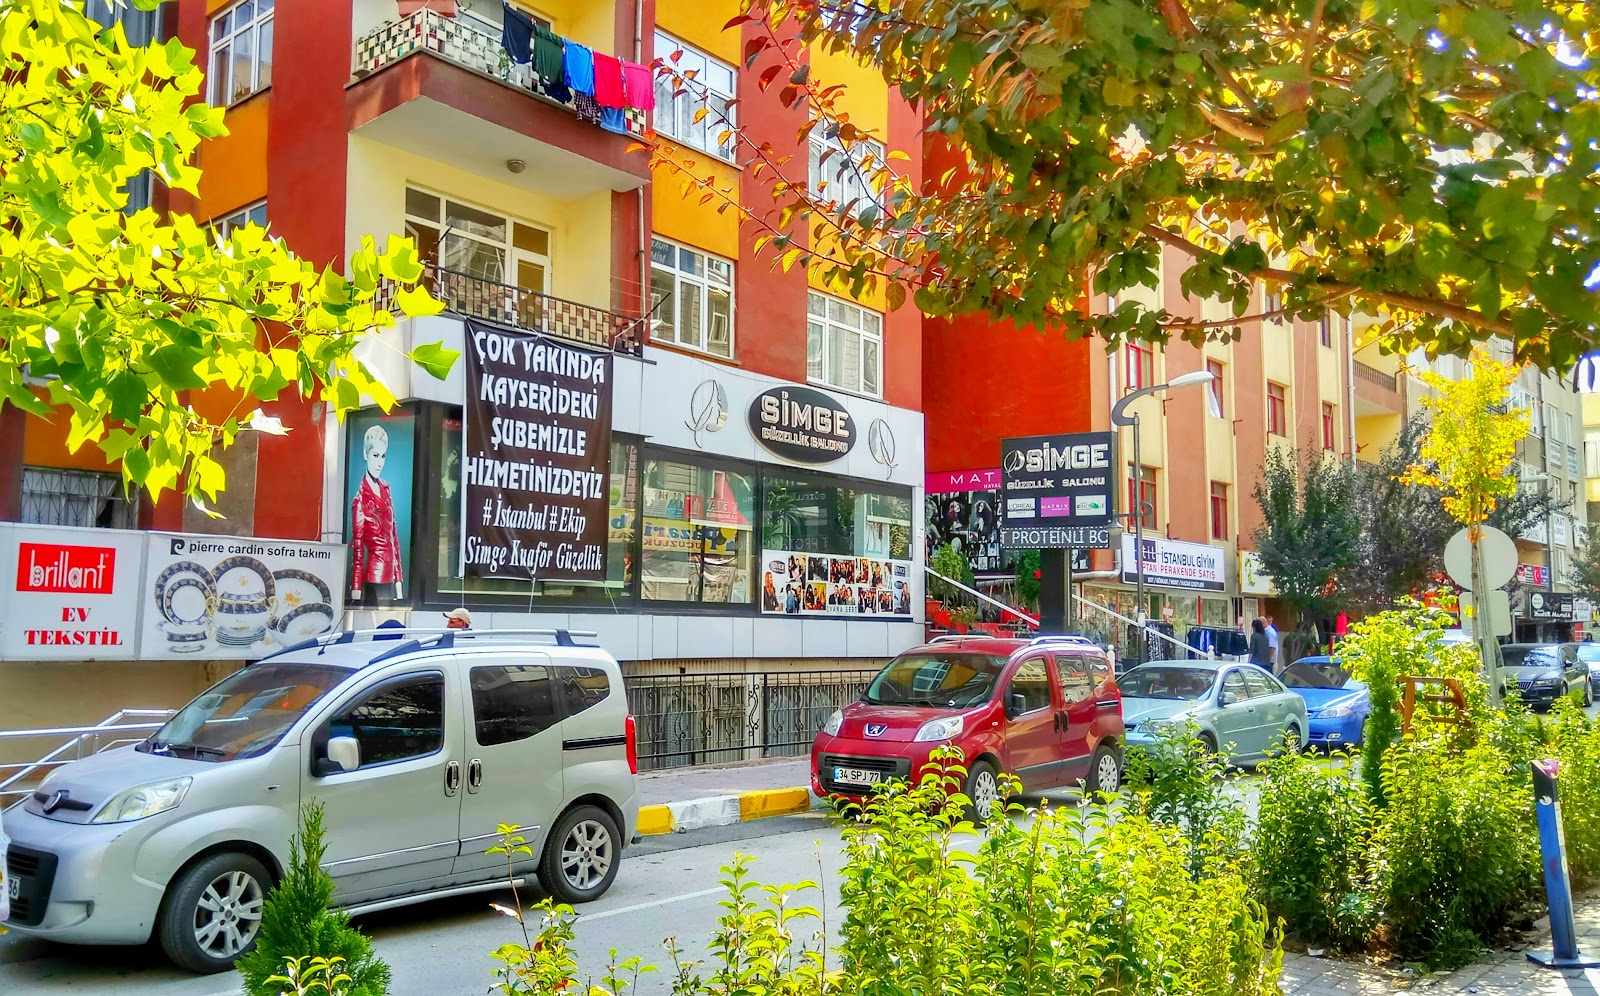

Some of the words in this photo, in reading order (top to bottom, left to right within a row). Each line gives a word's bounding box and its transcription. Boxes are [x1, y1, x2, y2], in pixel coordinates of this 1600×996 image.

[475, 331, 516, 365] ÇOK
[521, 340, 605, 384] YAKINDA
[481, 373, 598, 420] KAYSERİDEKİ
[760, 390, 850, 438] SİMGE
[491, 417, 586, 457] ŞUBEMİZLE
[761, 425, 810, 447] GÜZELLİK
[810, 437, 848, 453] SALONU
[1026, 442, 1109, 473] SİMGE
[466, 451, 604, 500] HİZMETİNİZDEYİZ
[950, 472, 995, 485] MAT
[1006, 478, 1054, 490] GÜZELLİK
[1062, 477, 1105, 487] SALONU
[190, 541, 225, 554] pierre
[228, 543, 264, 555] cardin
[267, 545, 296, 557] sofra
[299, 548, 331, 560] takımı
[465, 536, 507, 573] Simge
[509, 540, 553, 575] Kuaför
[556, 543, 602, 573] Güzellik
[1161, 547, 1195, 567] İSTANBUL
[1196, 554, 1215, 569] GİYİM
[28, 549, 107, 589] brillant
[1160, 565, 1196, 577] PERAKENDE
[1198, 570, 1215, 581] SATIŞ
[61, 606, 91, 622] EV
[24, 626, 123, 646] TEKSTİL
[838, 770, 848, 779] 34
[851, 770, 867, 780] SPJ
[869, 772, 880, 782] 77
